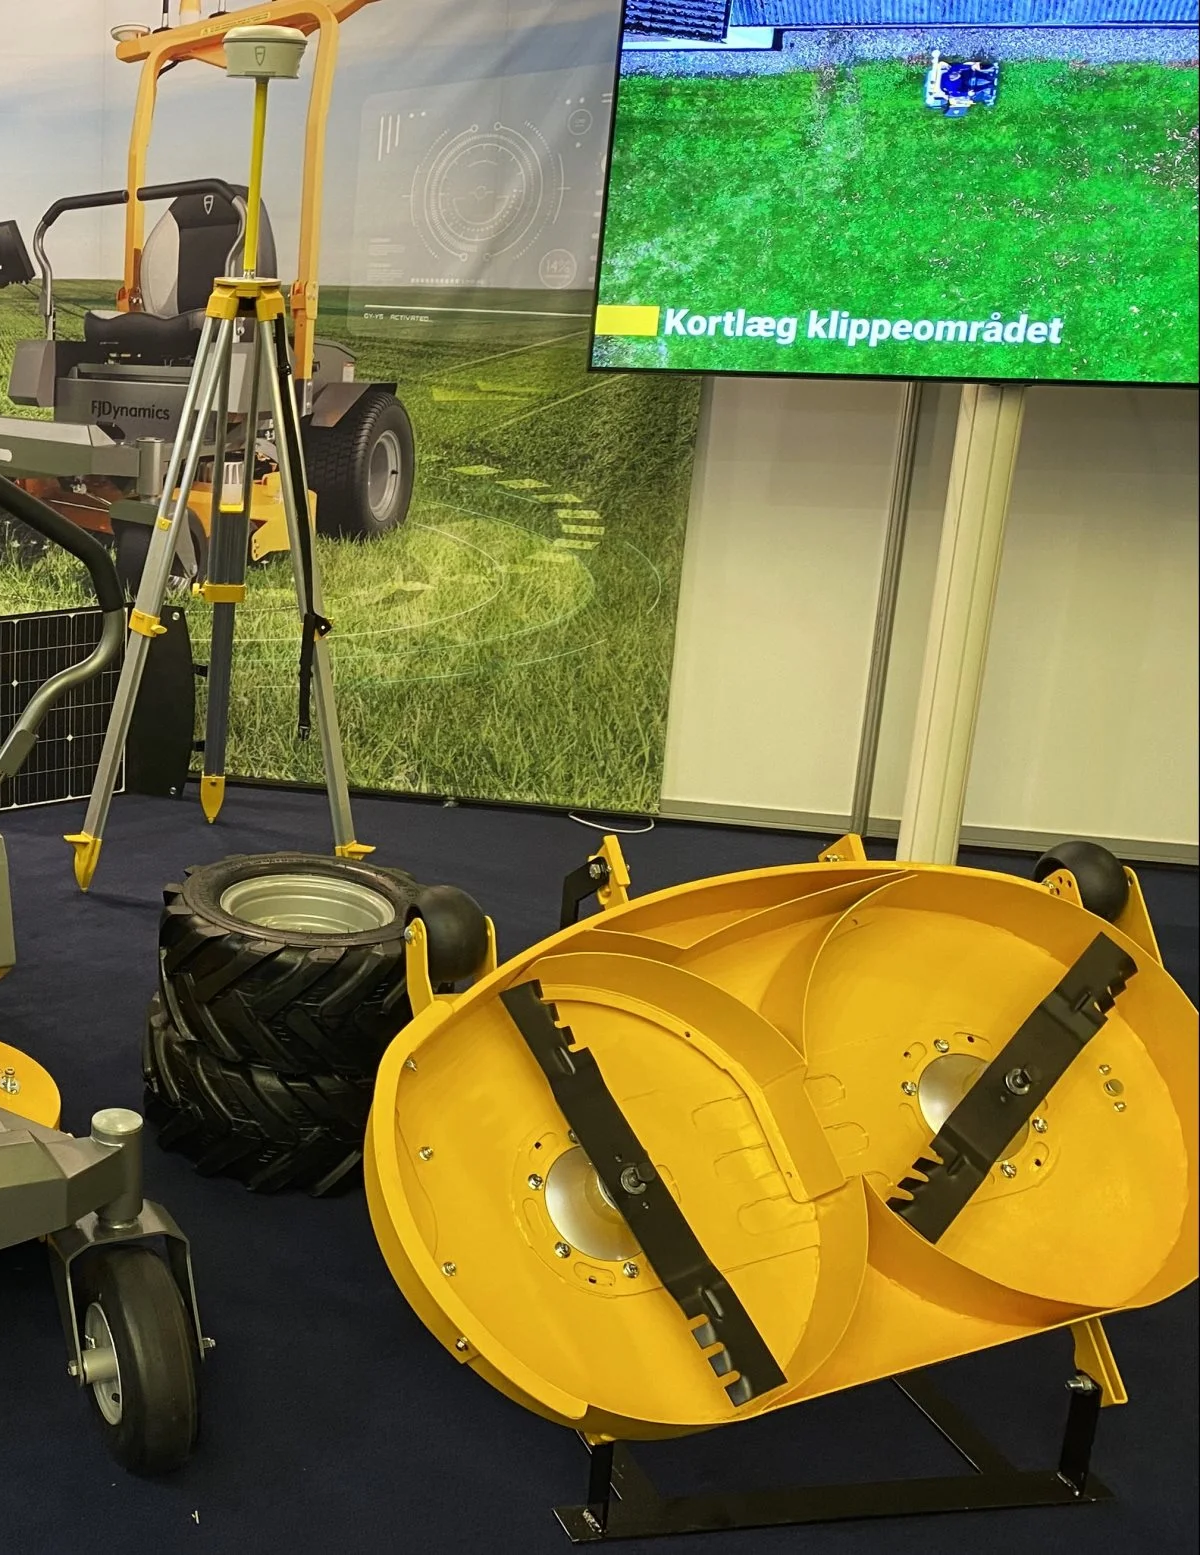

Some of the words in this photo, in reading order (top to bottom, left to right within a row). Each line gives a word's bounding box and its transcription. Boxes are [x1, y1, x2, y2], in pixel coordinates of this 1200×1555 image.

[664, 308, 798, 345] Kortlæg
[807, 310, 1064, 347] klippeområdet
[91, 400, 170, 420] FJDynamics
